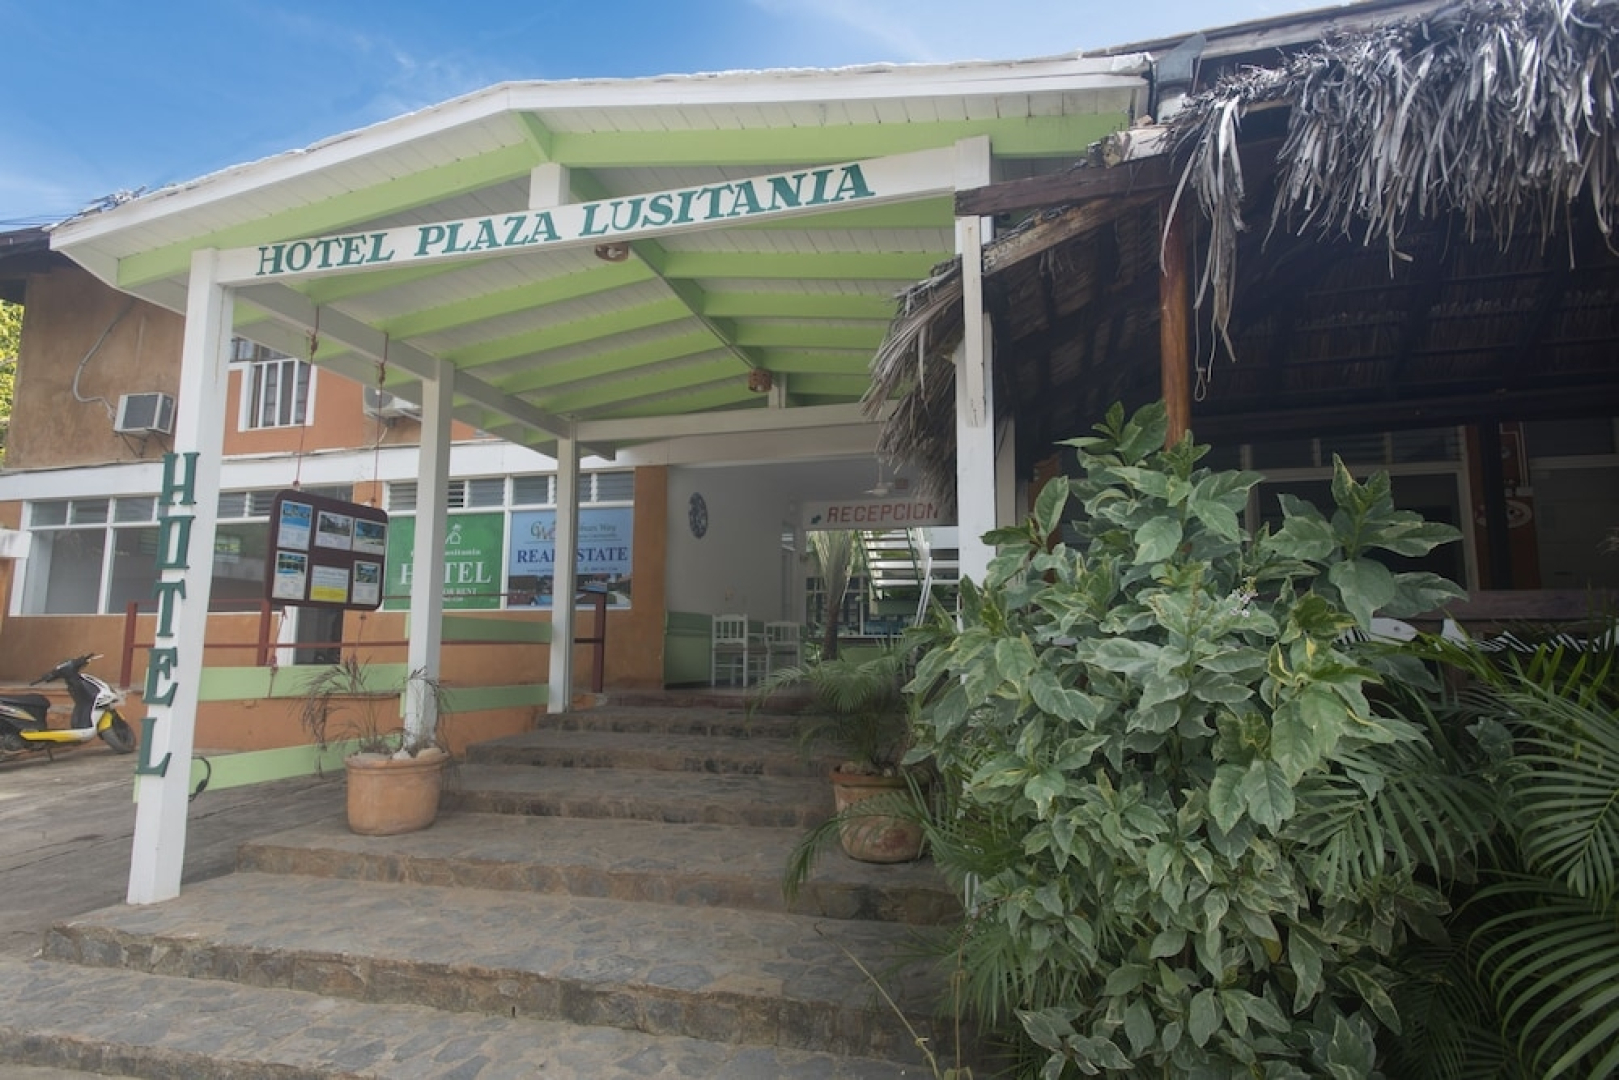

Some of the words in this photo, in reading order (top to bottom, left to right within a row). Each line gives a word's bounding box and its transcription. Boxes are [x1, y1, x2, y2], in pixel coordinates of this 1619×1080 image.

[255, 231, 396, 277] HOTEL
[413, 209, 561, 256] PLAZA
[578, 162, 875, 238] LUSITANIA
[826, 502, 939, 524] RECEPCION
[576, 547, 628, 563] STATE
[400, 561, 492, 585] HTEL
[135, 451, 200, 778] HOTEL
